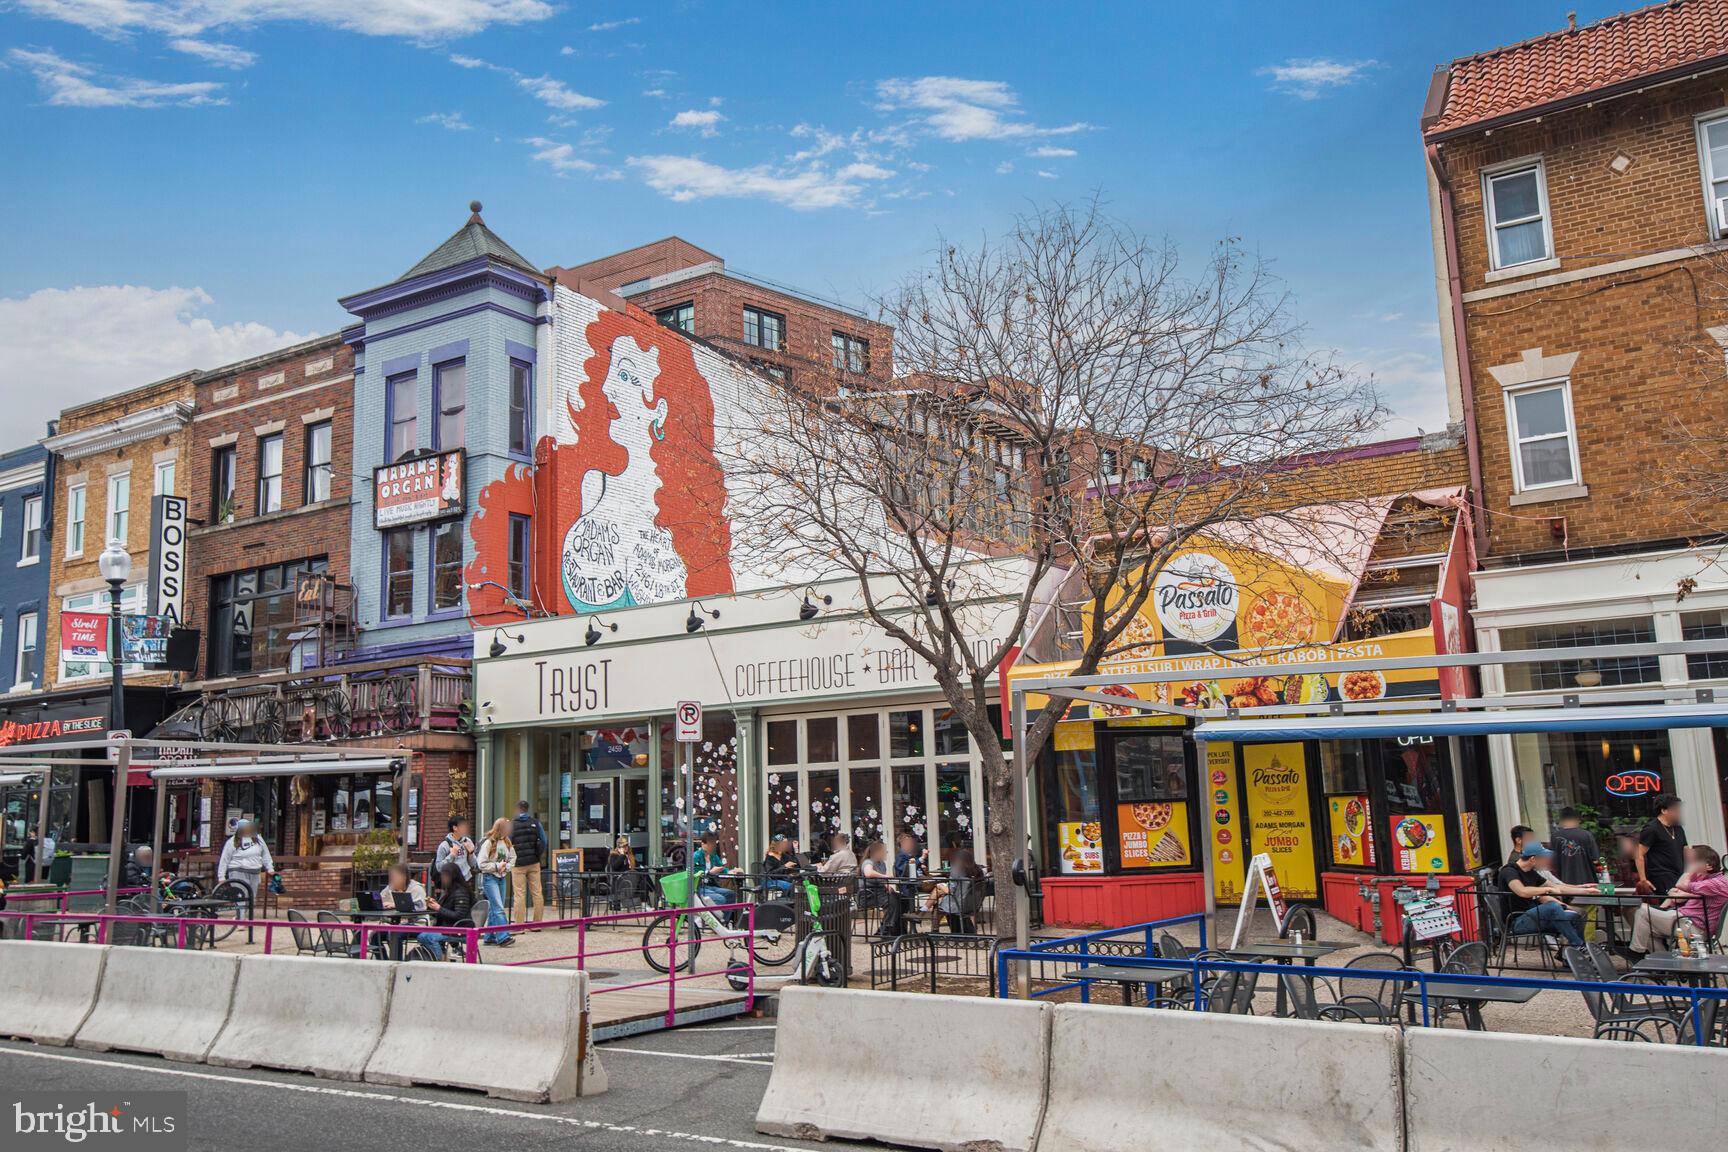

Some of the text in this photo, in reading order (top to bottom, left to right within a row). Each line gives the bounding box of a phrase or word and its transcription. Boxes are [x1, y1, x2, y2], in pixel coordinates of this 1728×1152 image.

[377, 457, 438, 484] MADAM'S
[381, 474, 434, 498] ORGAN
[573, 535, 615, 565] ORGAN
[638, 529, 672, 550] THE HEART
[162, 499, 182, 624] BOSSA
[633, 543, 656, 569] ADAMS
[653, 547, 660, 557] OF
[564, 550, 598, 602] RESTAURANT
[604, 570, 625, 598] BAR
[634, 563, 655, 591] 2461
[298, 578, 321, 602] Eat
[1159, 581, 1233, 614] Passato
[71, 618, 98, 629] Stroll
[1179, 610, 1196, 620] Pizza
[1203, 608, 1217, 617] Grill
[72, 632, 96, 641] TIME
[1101, 664, 1138, 675] ATTER
[1182, 658, 1221, 671] WRAP
[1278, 649, 1328, 665] KABOB
[1337, 643, 1383, 659] PASTA
[735, 653, 855, 697] COFFEEHOUSE
[877, 647, 918, 683] BAR
[16, 719, 103, 741] PIZZA BY THE SLICE
[1252, 767, 1300, 787] Passato
[1606, 775, 1661, 791] OPEN
[1122, 831, 1142, 841] PIZZA
[1123, 840, 1148, 849] JUMBO
[1264, 836, 1299, 847] JUMBO
[1084, 851, 1100, 859] SUBS
[1124, 849, 1149, 858] SLICES
[1400, 849, 1410, 870] KEBAB
